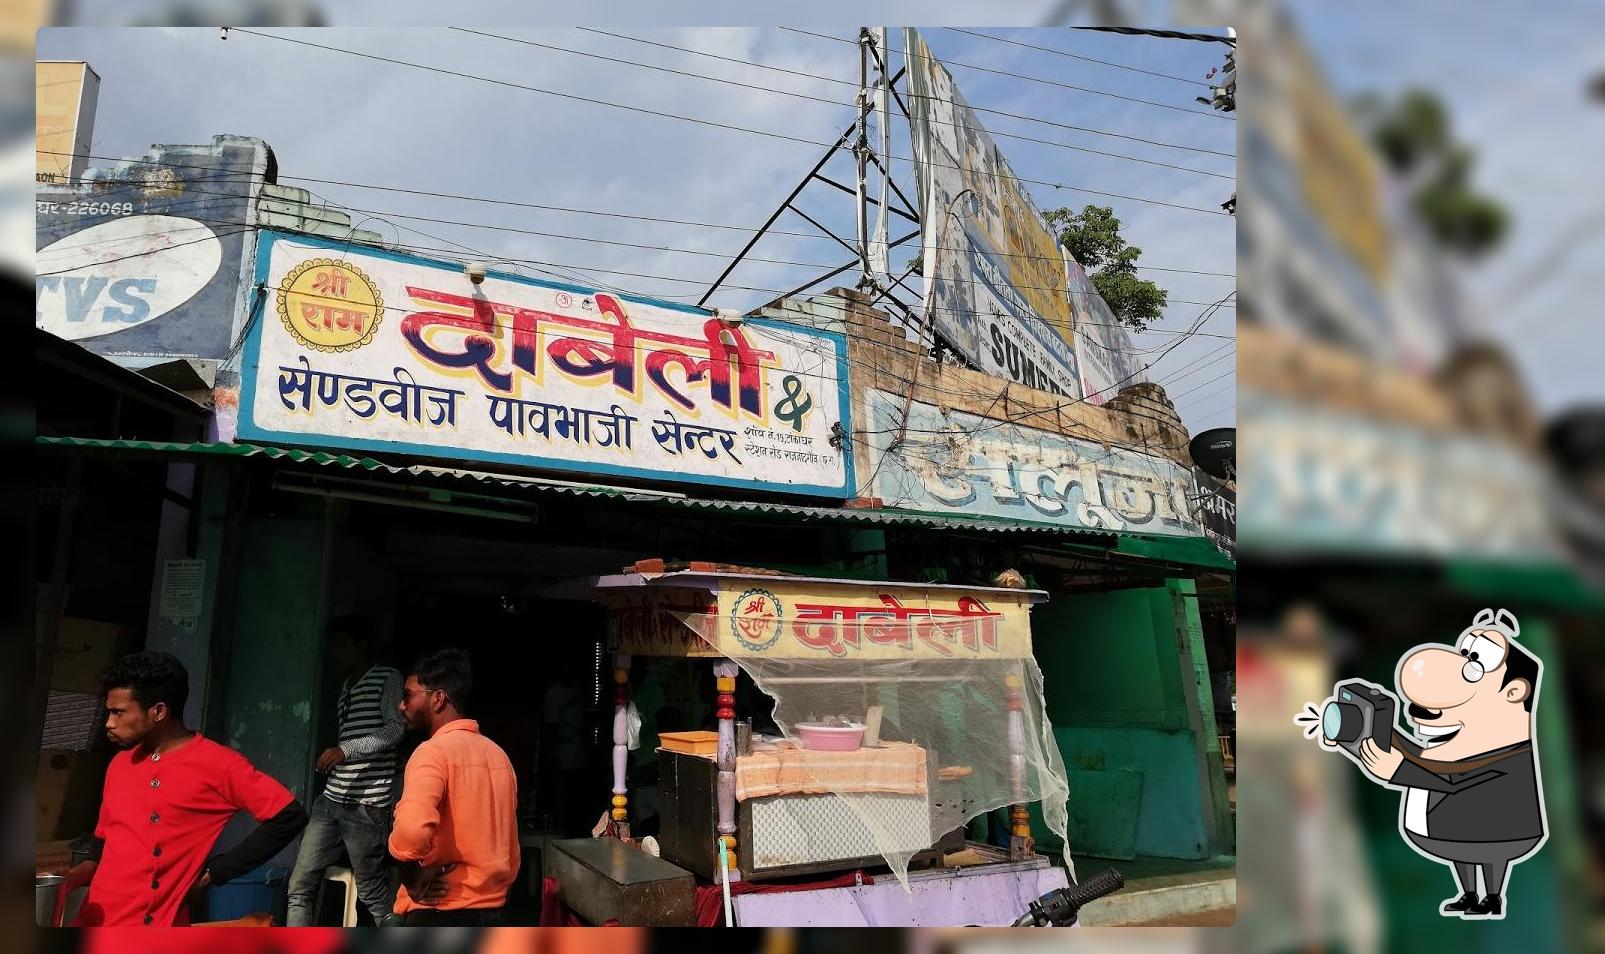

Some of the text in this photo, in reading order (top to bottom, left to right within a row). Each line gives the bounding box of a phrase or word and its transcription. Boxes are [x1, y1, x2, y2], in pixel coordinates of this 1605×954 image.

[311, 268, 351, 298] श्री
[300, 302, 369, 337] राम
[400, 286, 812, 432] दाबेली &
[485, 394, 638, 450] पावभाजी
[652, 410, 743, 465] सेन्टर
[744, 596, 766, 615] श्री
[791, 593, 1005, 658] दाबेली
